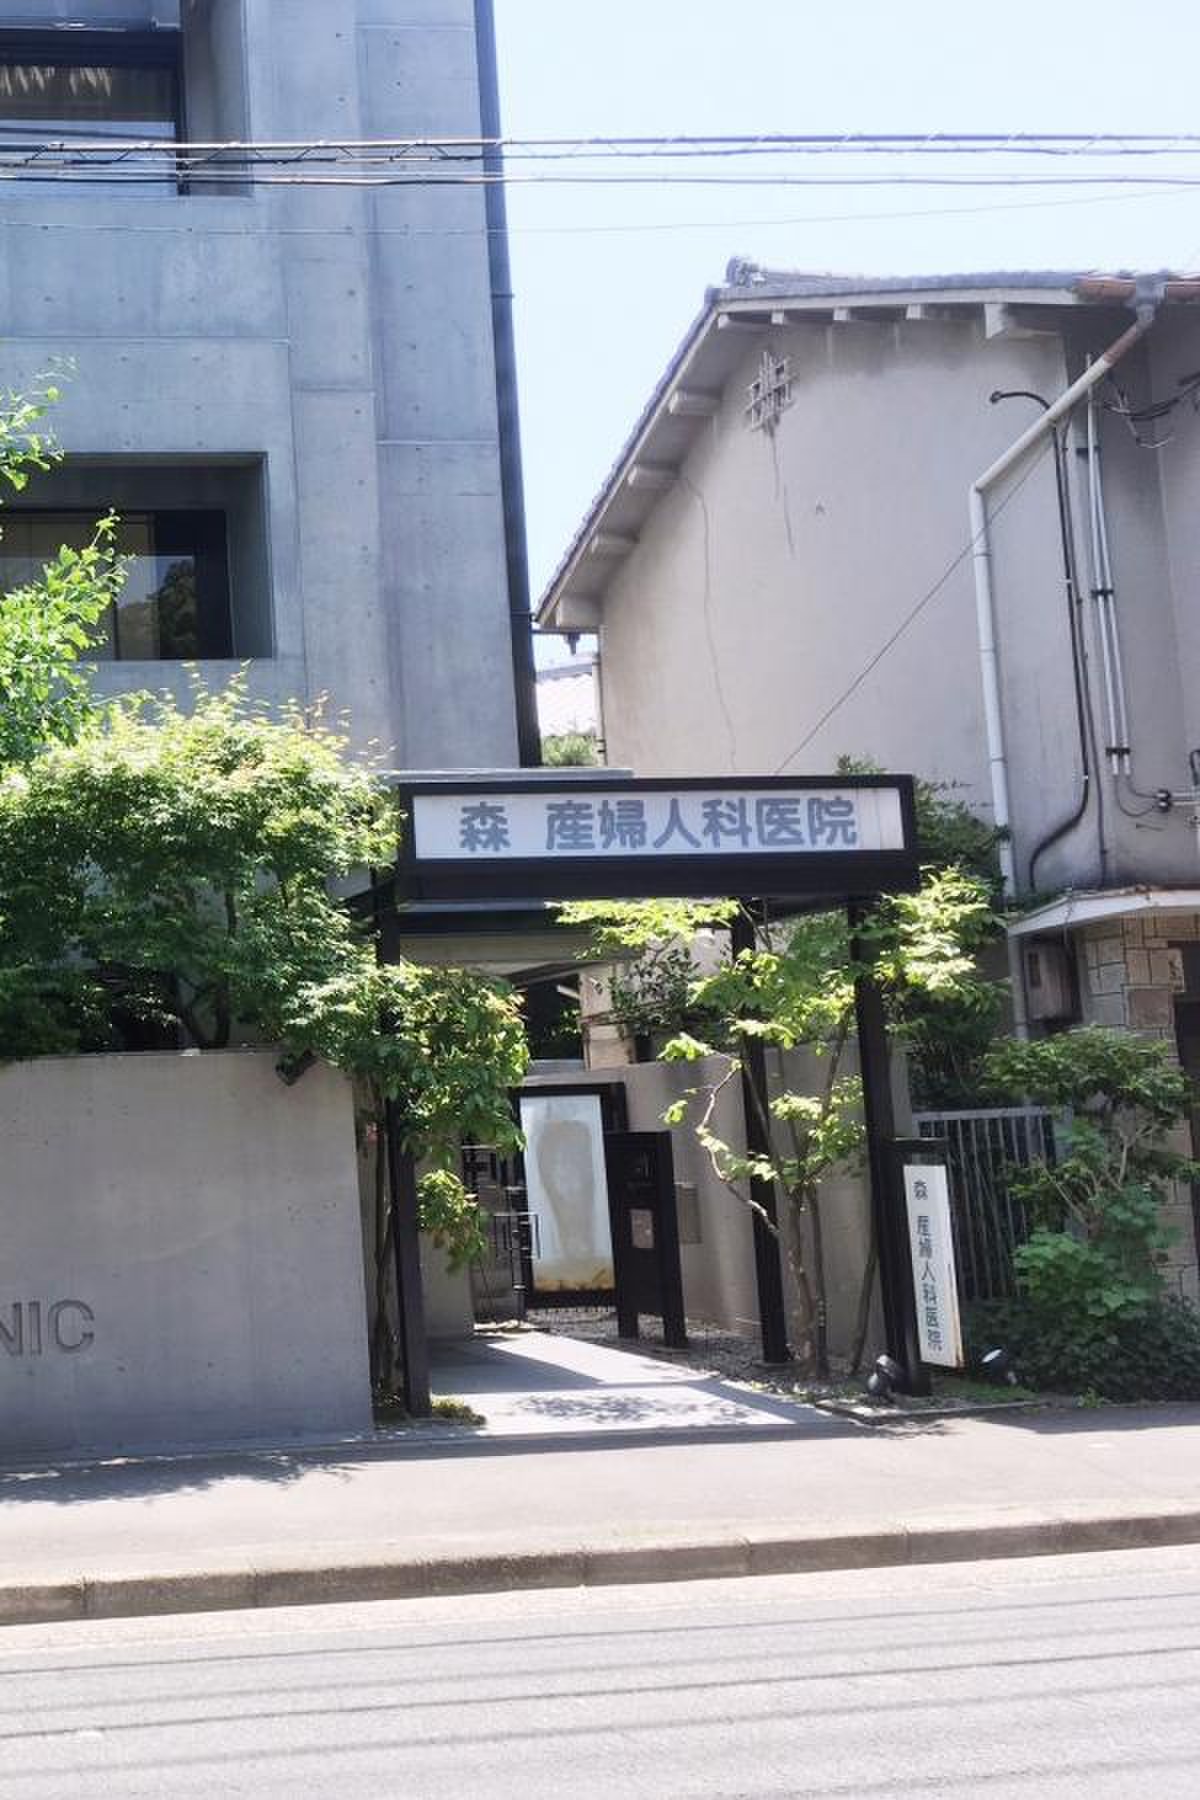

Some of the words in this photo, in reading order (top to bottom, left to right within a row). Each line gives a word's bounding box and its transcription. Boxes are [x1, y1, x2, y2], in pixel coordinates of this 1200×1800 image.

[459, 801, 511, 852] 森
[545, 796, 858, 851] 産婦人科医院
